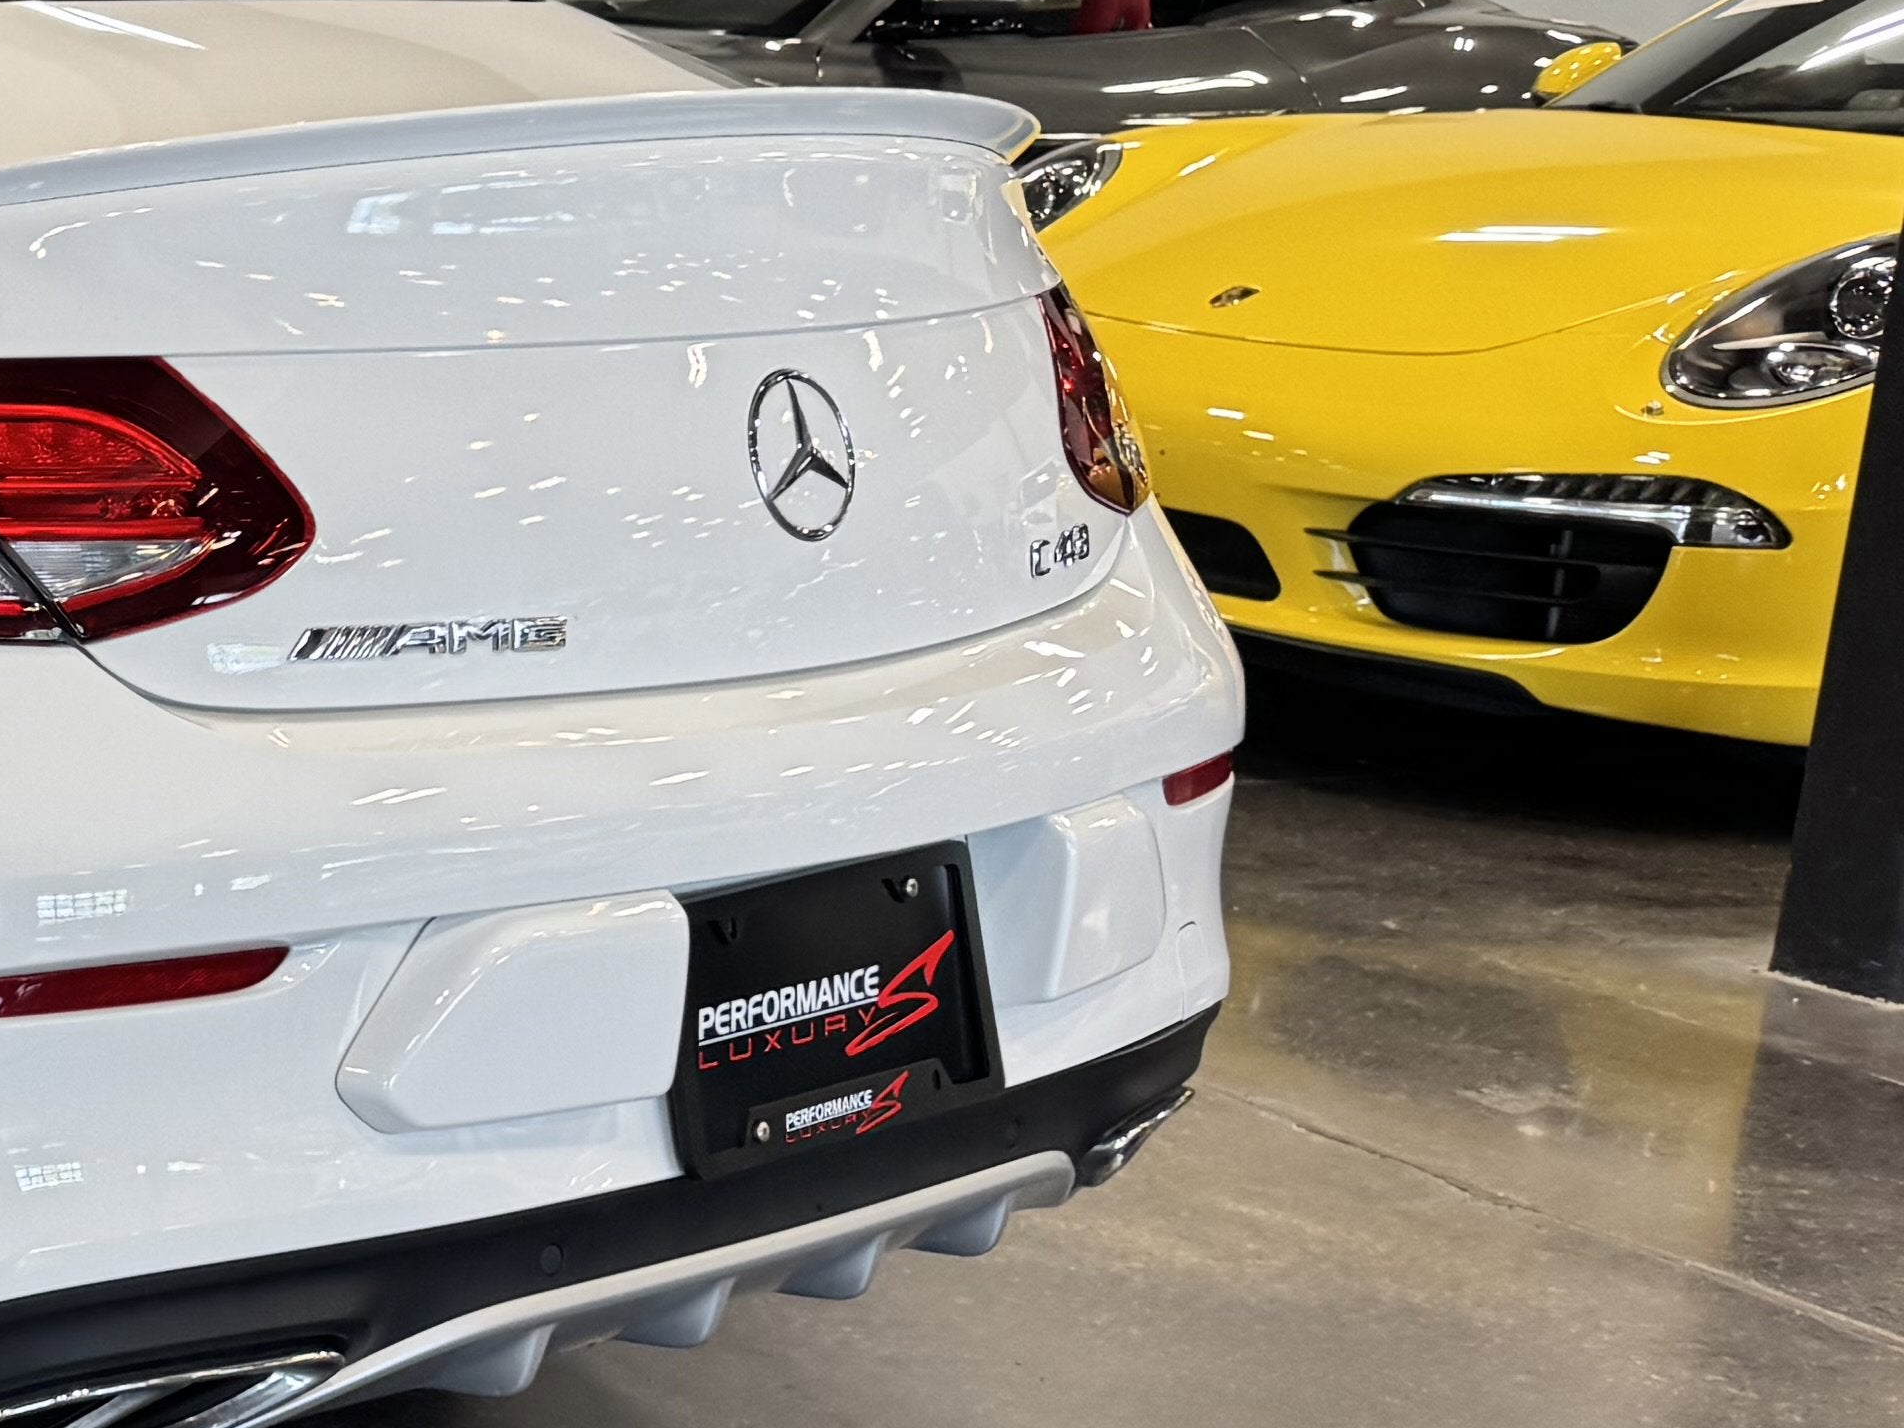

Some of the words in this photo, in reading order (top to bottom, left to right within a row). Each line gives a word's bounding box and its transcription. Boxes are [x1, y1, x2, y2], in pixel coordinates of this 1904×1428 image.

[1030, 540, 1051, 578] C
[1054, 523, 1089, 566] 43
[384, 615, 567, 656] AMG
[699, 964, 880, 1040] PERFORMANCE
[698, 1006, 876, 1070] LUXURY
[786, 1089, 872, 1128] PERFORMANCE
